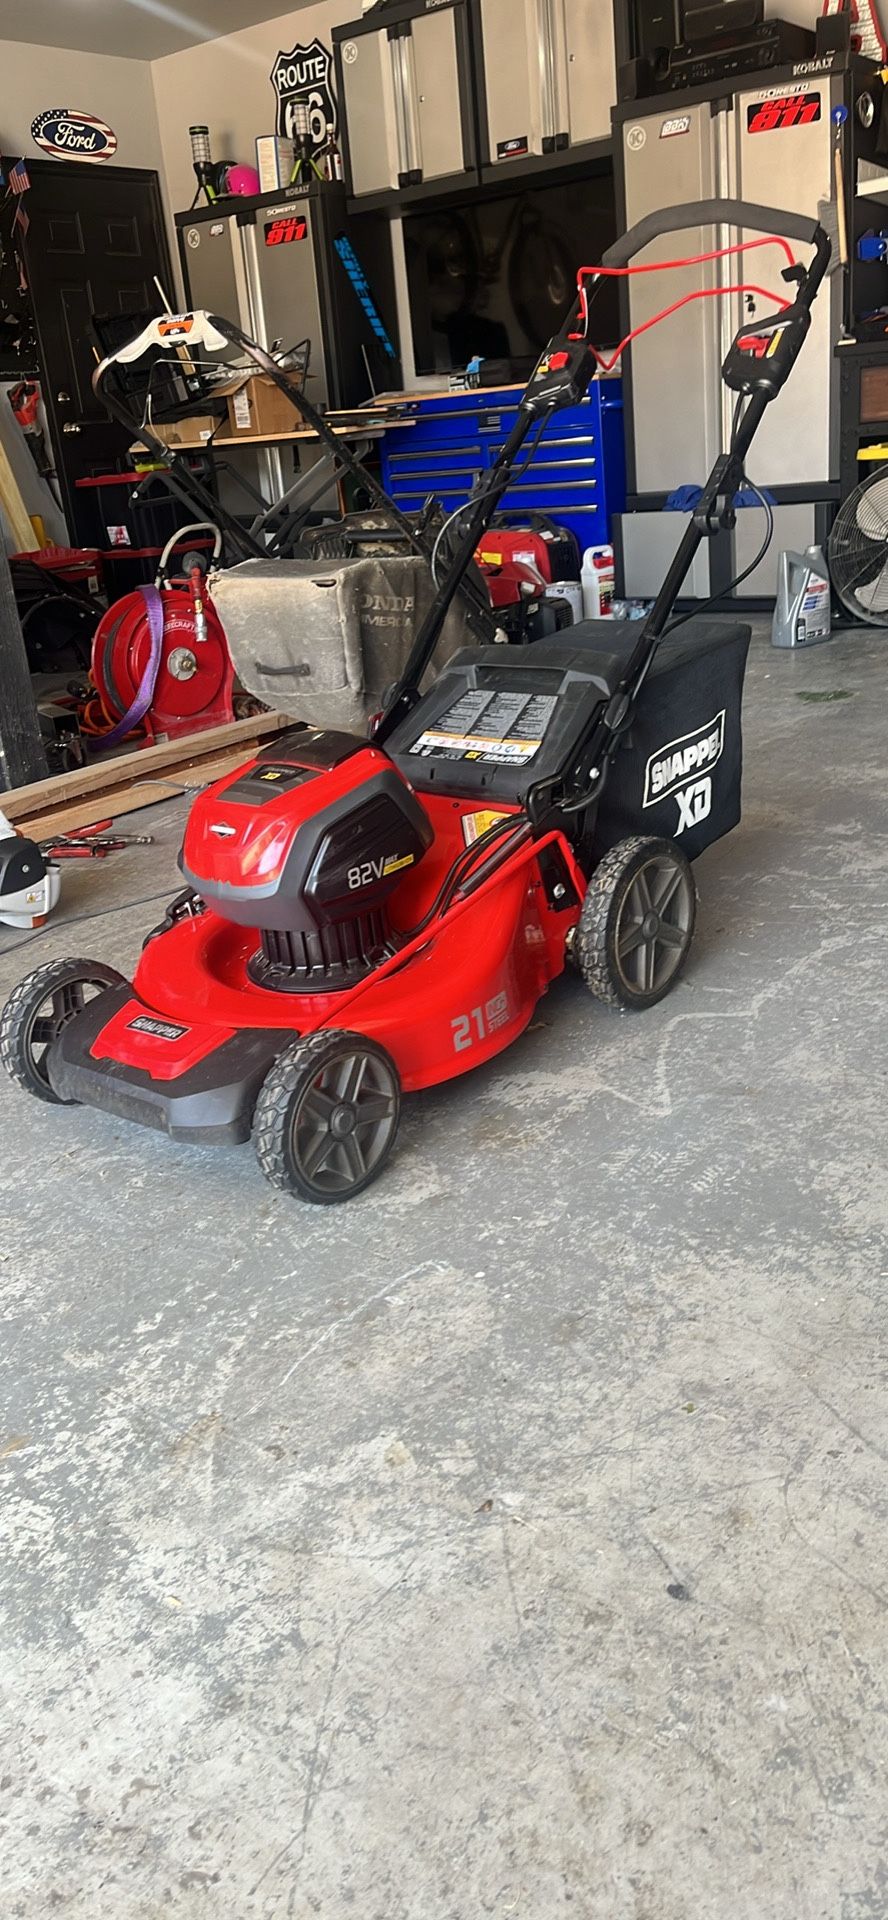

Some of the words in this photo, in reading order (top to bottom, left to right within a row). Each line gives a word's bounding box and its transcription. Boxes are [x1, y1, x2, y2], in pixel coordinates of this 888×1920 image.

[276, 56, 326, 90] ROUTE
[792, 57, 833, 76] KOBALT
[749, 102, 819, 132] 811
[761, 95, 806, 111] CALL
[54, 122, 96, 150] Ford
[361, 593, 415, 612] ONDA
[651, 727, 721, 795] SNAPPE
[672, 776, 712, 838] XD
[347, 856, 384, 890] 82V
[131, 1017, 184, 1039] SNAPPER
[450, 1006, 486, 1054] 21
